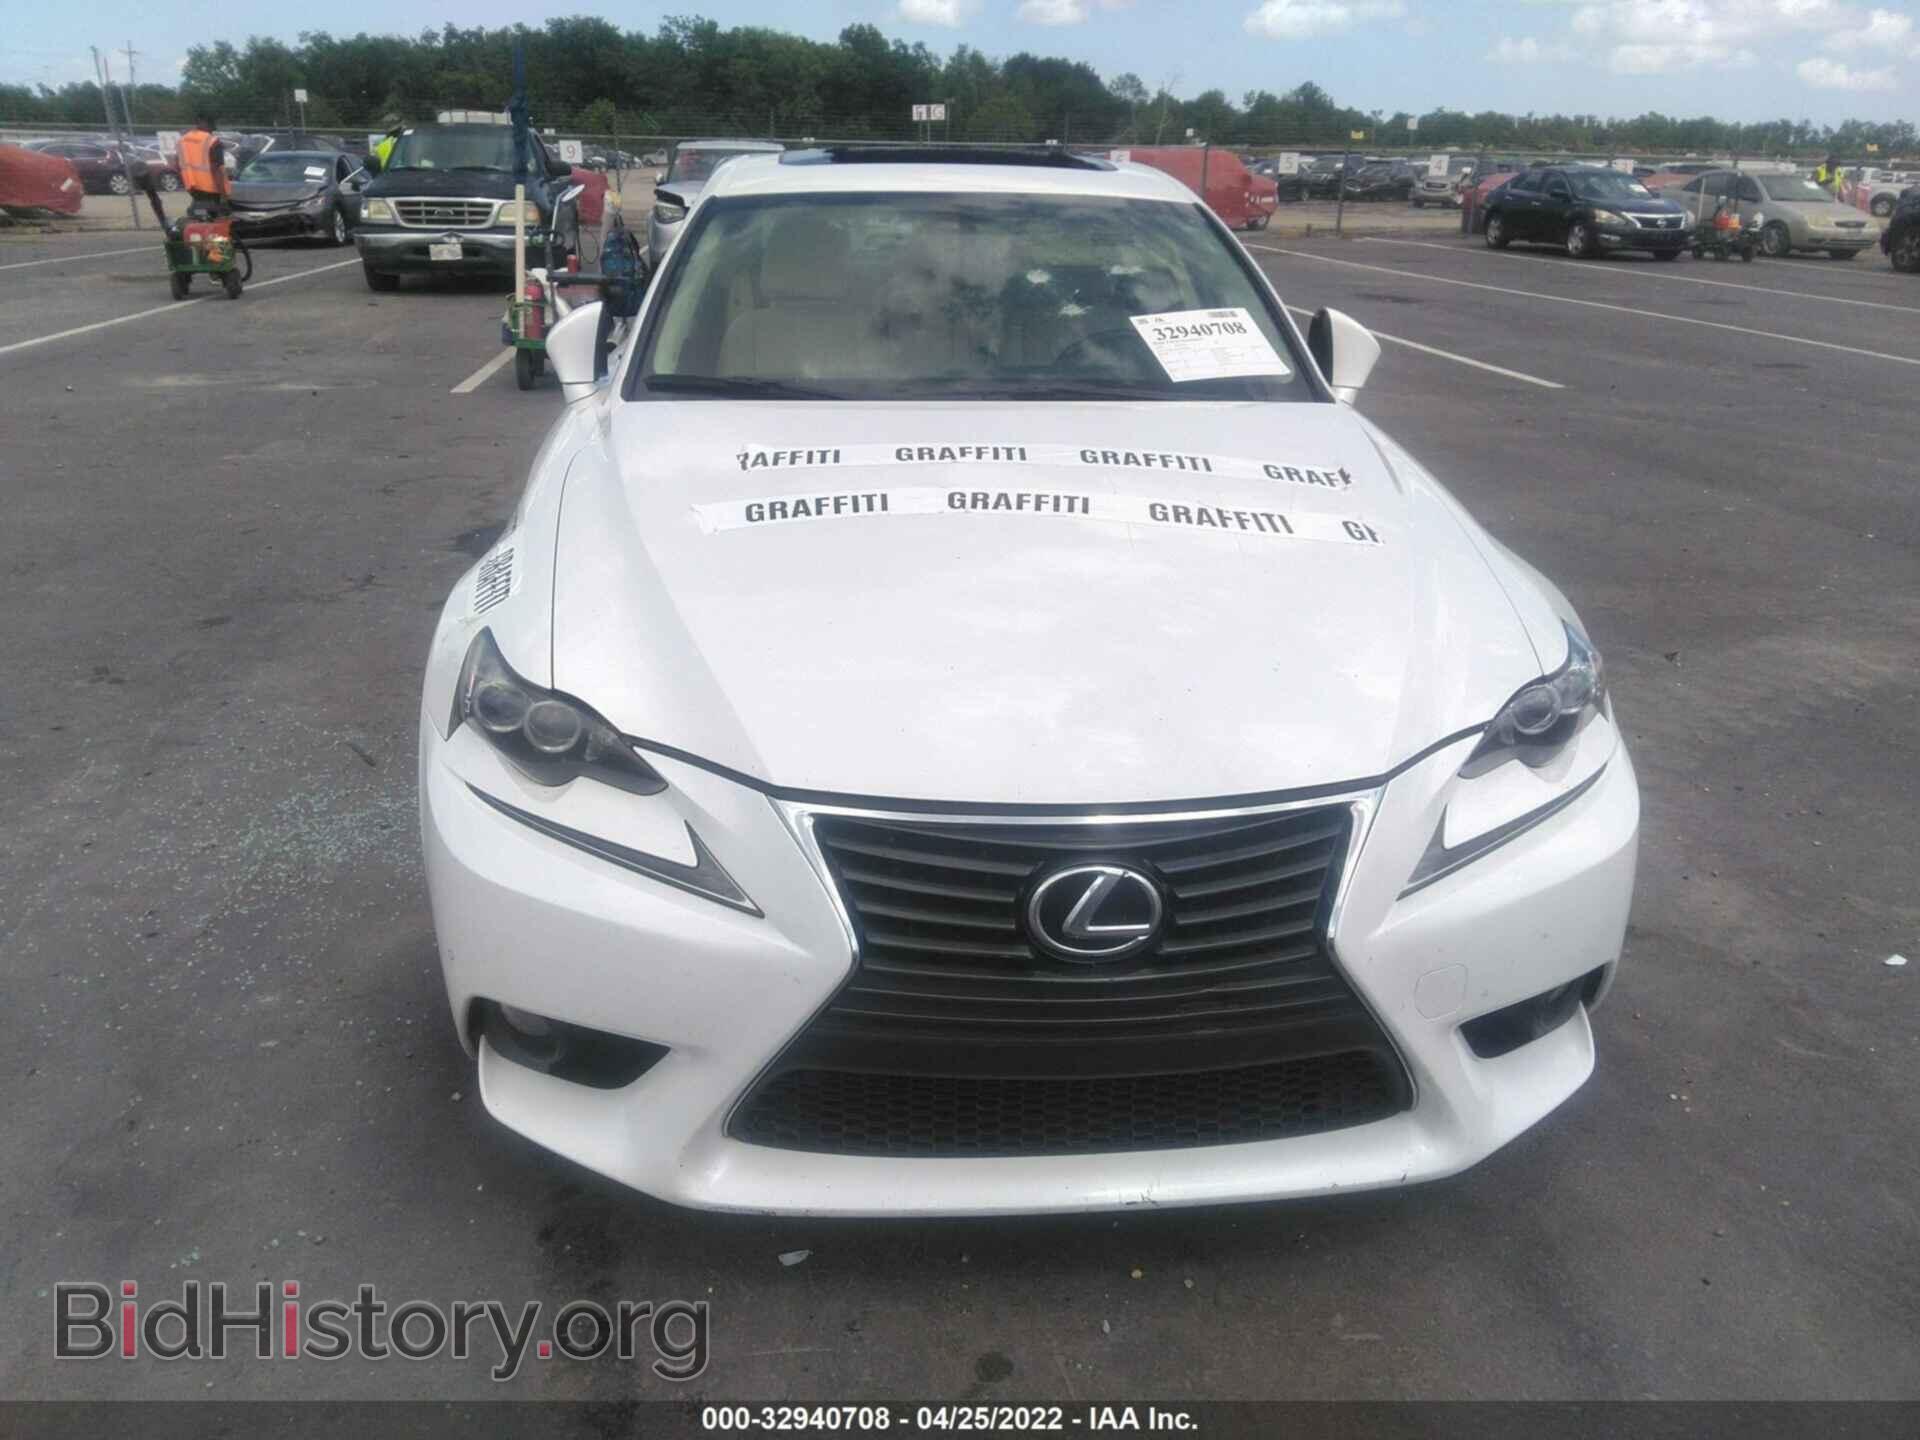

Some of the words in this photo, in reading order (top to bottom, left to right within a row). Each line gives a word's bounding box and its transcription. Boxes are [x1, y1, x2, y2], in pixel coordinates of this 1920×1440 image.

[566, 144, 576, 159] 9
[1152, 321, 1247, 340] 32940708
[895, 446, 1027, 462] GRAFFITI
[1080, 449, 1212, 472] GRAFFITI
[745, 493, 888, 522] GRAFFITI
[948, 491, 1089, 514] GRAFFITI
[1149, 503, 1294, 534] GRAFFITI
